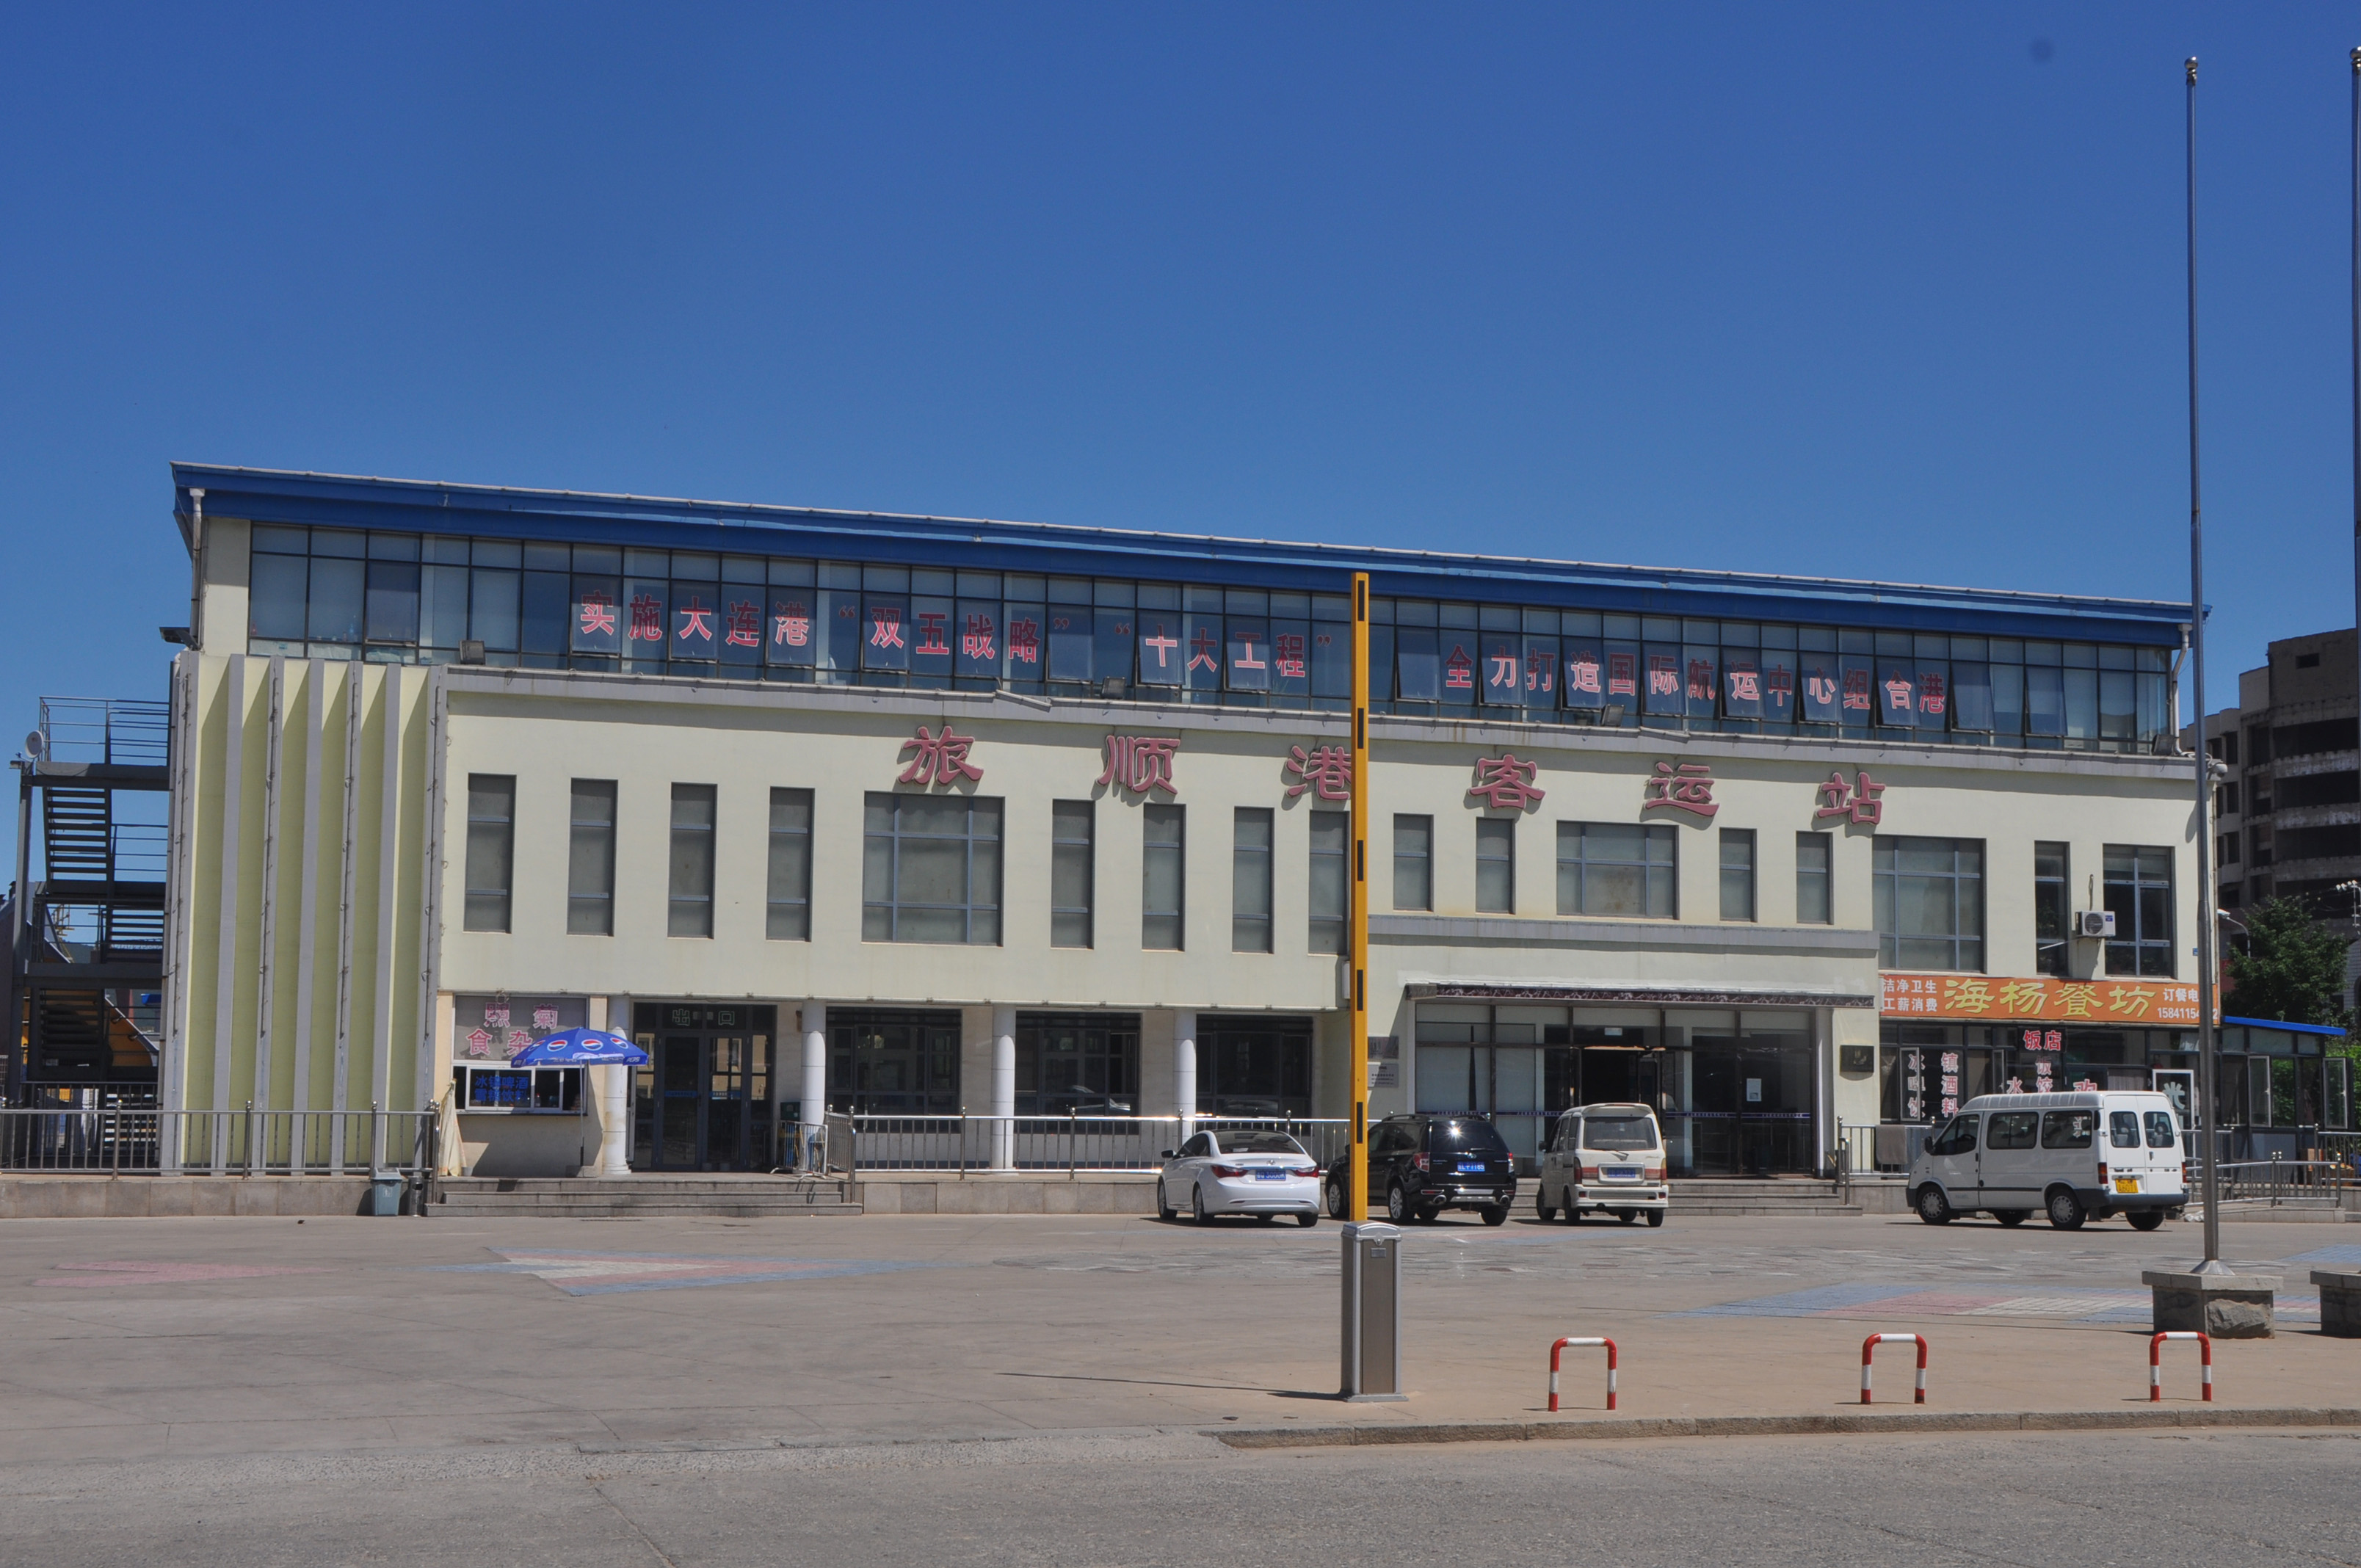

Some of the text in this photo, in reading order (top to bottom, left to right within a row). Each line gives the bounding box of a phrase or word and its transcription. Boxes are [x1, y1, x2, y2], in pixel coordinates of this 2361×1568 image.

[897, 725, 1885, 824] 旅顺港客运站
[1883, 979, 1937, 993] 洁净卫生
[2163, 987, 2199, 1002] 订餐电
[1884, 997, 1937, 1012] 工薪消费
[1943, 978, 2156, 1018] 海杨餐坊
[2158, 1007, 2218, 1020] 15841152
[465, 1028, 533, 1056] 食杂
[2023, 1030, 2062, 1051] 饭店
